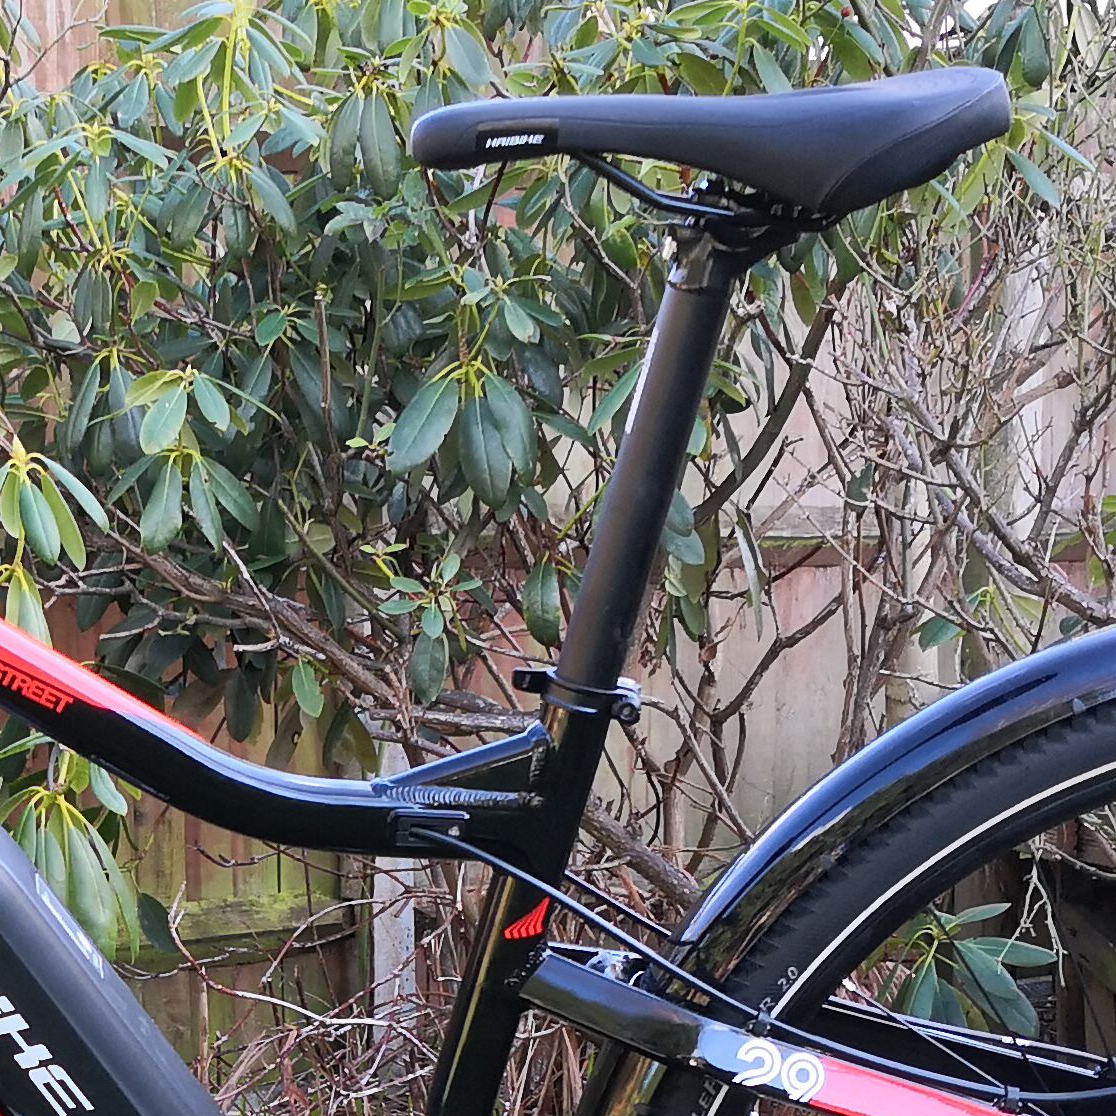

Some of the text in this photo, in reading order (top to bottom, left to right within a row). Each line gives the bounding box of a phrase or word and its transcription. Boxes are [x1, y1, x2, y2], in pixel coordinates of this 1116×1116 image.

[485, 134, 545, 149] HAIBIKE
[776, 966, 798, 991] 2.0
[732, 1038, 826, 1103] 29
